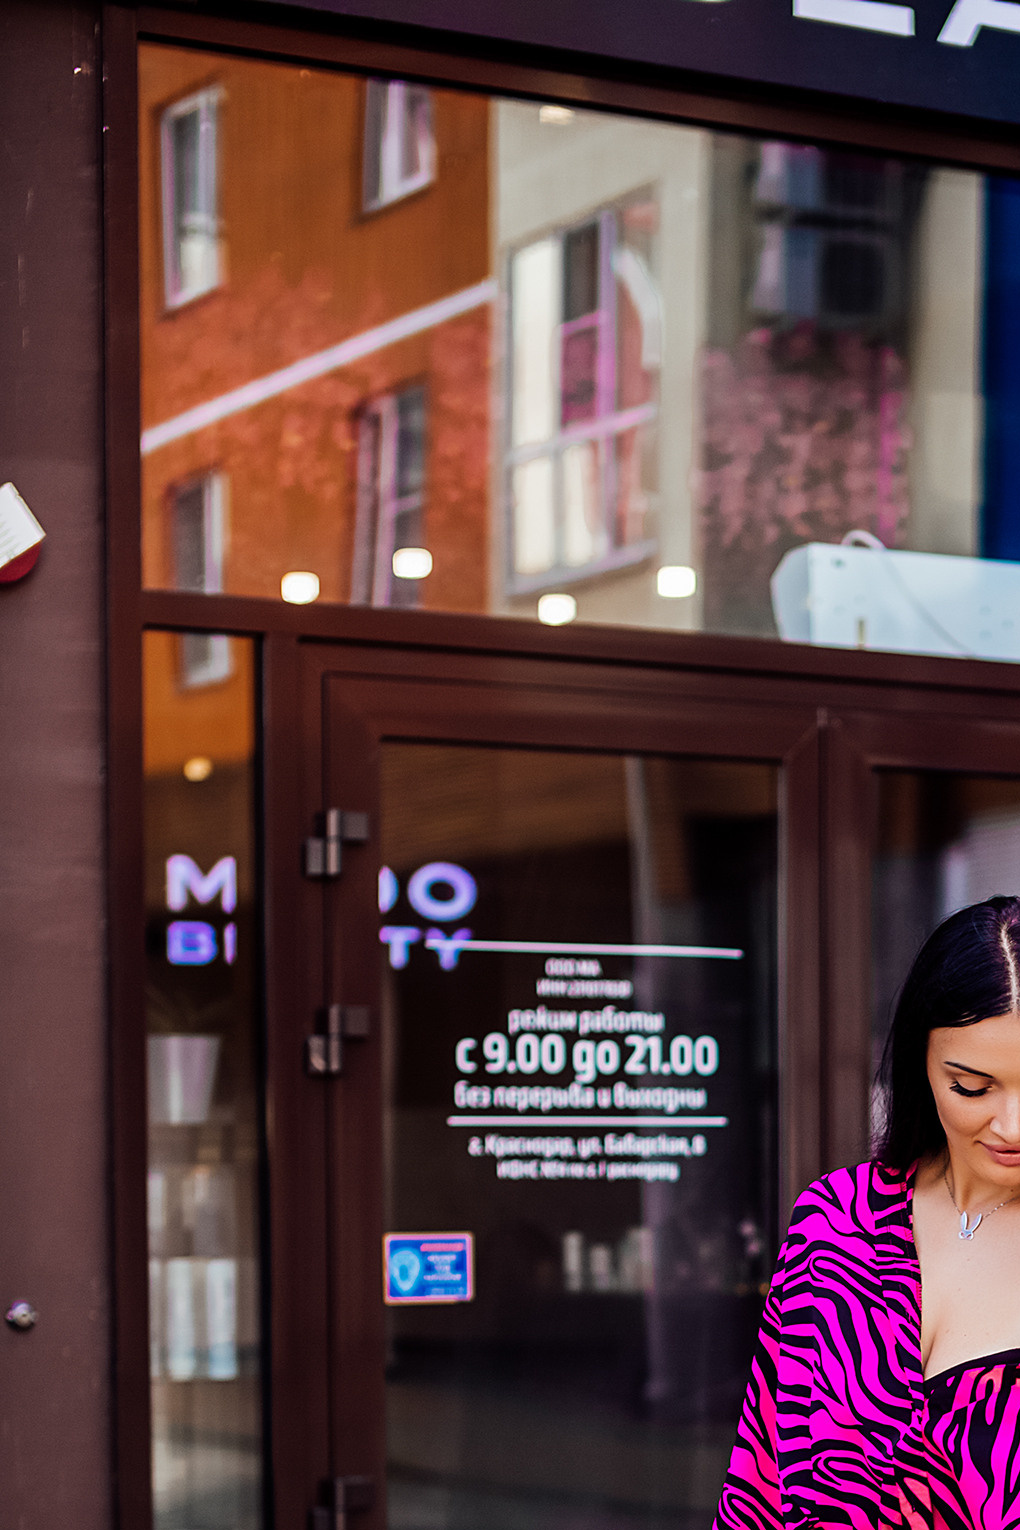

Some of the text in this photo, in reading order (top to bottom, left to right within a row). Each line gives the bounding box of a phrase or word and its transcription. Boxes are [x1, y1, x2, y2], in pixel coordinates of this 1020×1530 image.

[578, 1005, 665, 1035] работы
[482, 1032, 566, 1075] 9.00
[624, 1034, 719, 1076] 21.00
[454, 1080, 491, 1109] без
